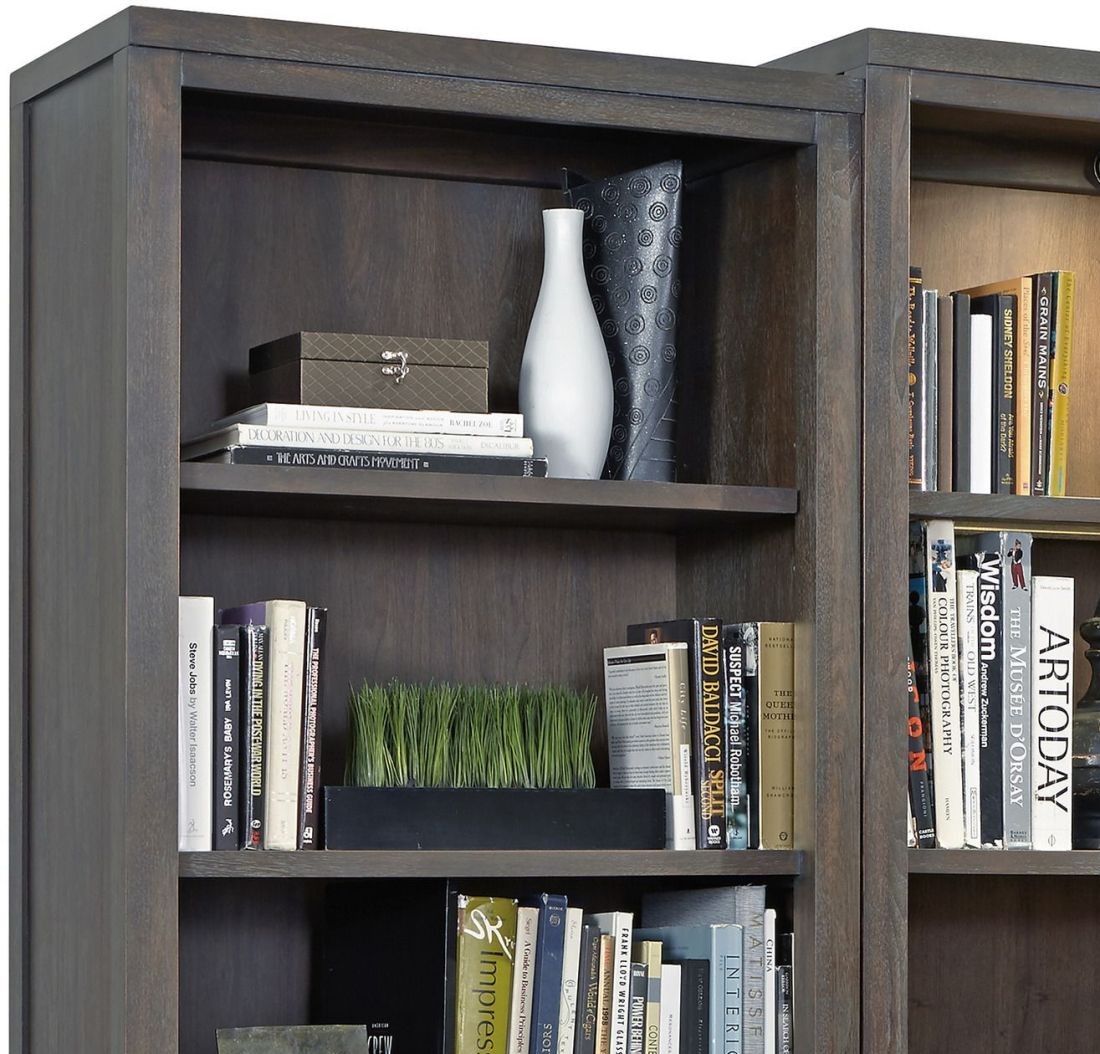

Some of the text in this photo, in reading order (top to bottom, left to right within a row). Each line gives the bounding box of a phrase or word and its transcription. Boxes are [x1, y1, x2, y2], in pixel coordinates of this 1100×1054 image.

[1038, 297, 1048, 388] GRAIN MAINS
[1004, 350, 1012, 398] SHELDON
[249, 428, 421, 448] DECORATION AND DESIGN FOR THE
[277, 452, 420, 470] THE ARTS AND CRAFTS MOVEMENT
[966, 584, 975, 623] TRAINS
[980, 560, 999, 660] Wisdom
[252, 661, 263, 688] DYING
[938, 598, 952, 755] COLOUR PHOTOGRAPHY
[1010, 607, 1026, 717] THE MUSÉE
[252, 690, 262, 698] IN
[310, 661, 318, 705] PROFESSIONAL
[702, 625, 720, 762] DAVID BALDACCI
[967, 680, 976, 712] WEST
[188, 697, 197, 708] by
[252, 699, 262, 716] THE
[1038, 626, 1069, 813] ARTODAY
[224, 718, 232, 742] BABY
[252, 719, 262, 762] POST-WAR
[730, 646, 742, 805] SUSPECT Michael Robotham
[252, 764, 261, 796] WORLD
[709, 770, 724, 817] SPLIT
[701, 780, 709, 819] SECOND
[619, 928, 629, 956] FRANK
[618, 959, 627, 986] LLOYD
[519, 980, 529, 1014] Business
[587, 983, 596, 1008] World
[616, 991, 625, 1026] WRIGHT
[632, 997, 643, 1026] POWER
[516, 1016, 526, 1053] Principles
[782, 1046, 790, 1054] OF
